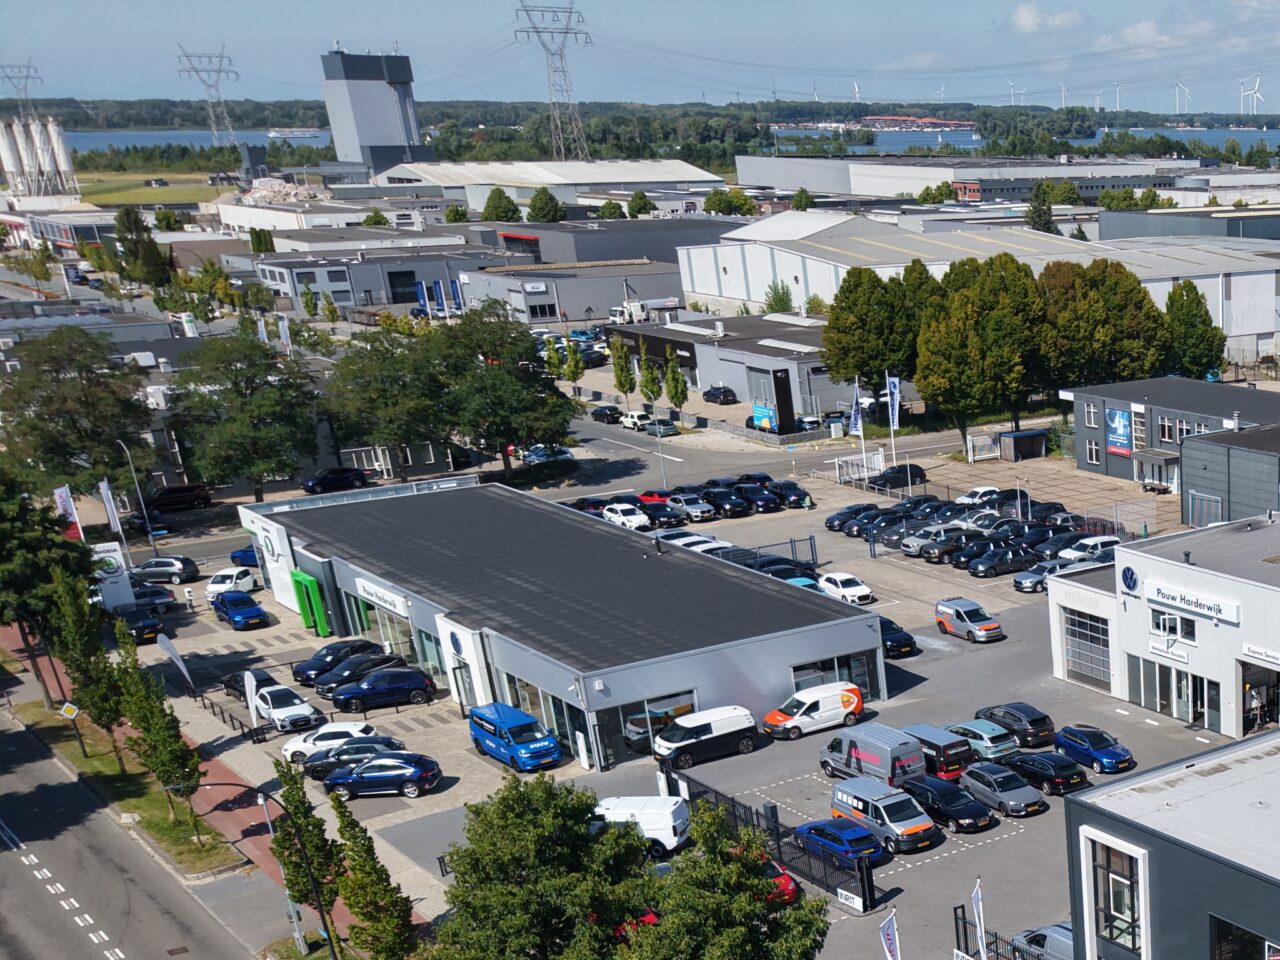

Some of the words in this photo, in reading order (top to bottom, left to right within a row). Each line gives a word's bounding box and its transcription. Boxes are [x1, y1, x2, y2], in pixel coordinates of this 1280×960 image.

[1156, 588, 1177, 602] Pouw
[1180, 594, 1223, 615] Harderwijk
[1247, 646, 1264, 657] Express
[838, 890, 855, 906] INRIT
